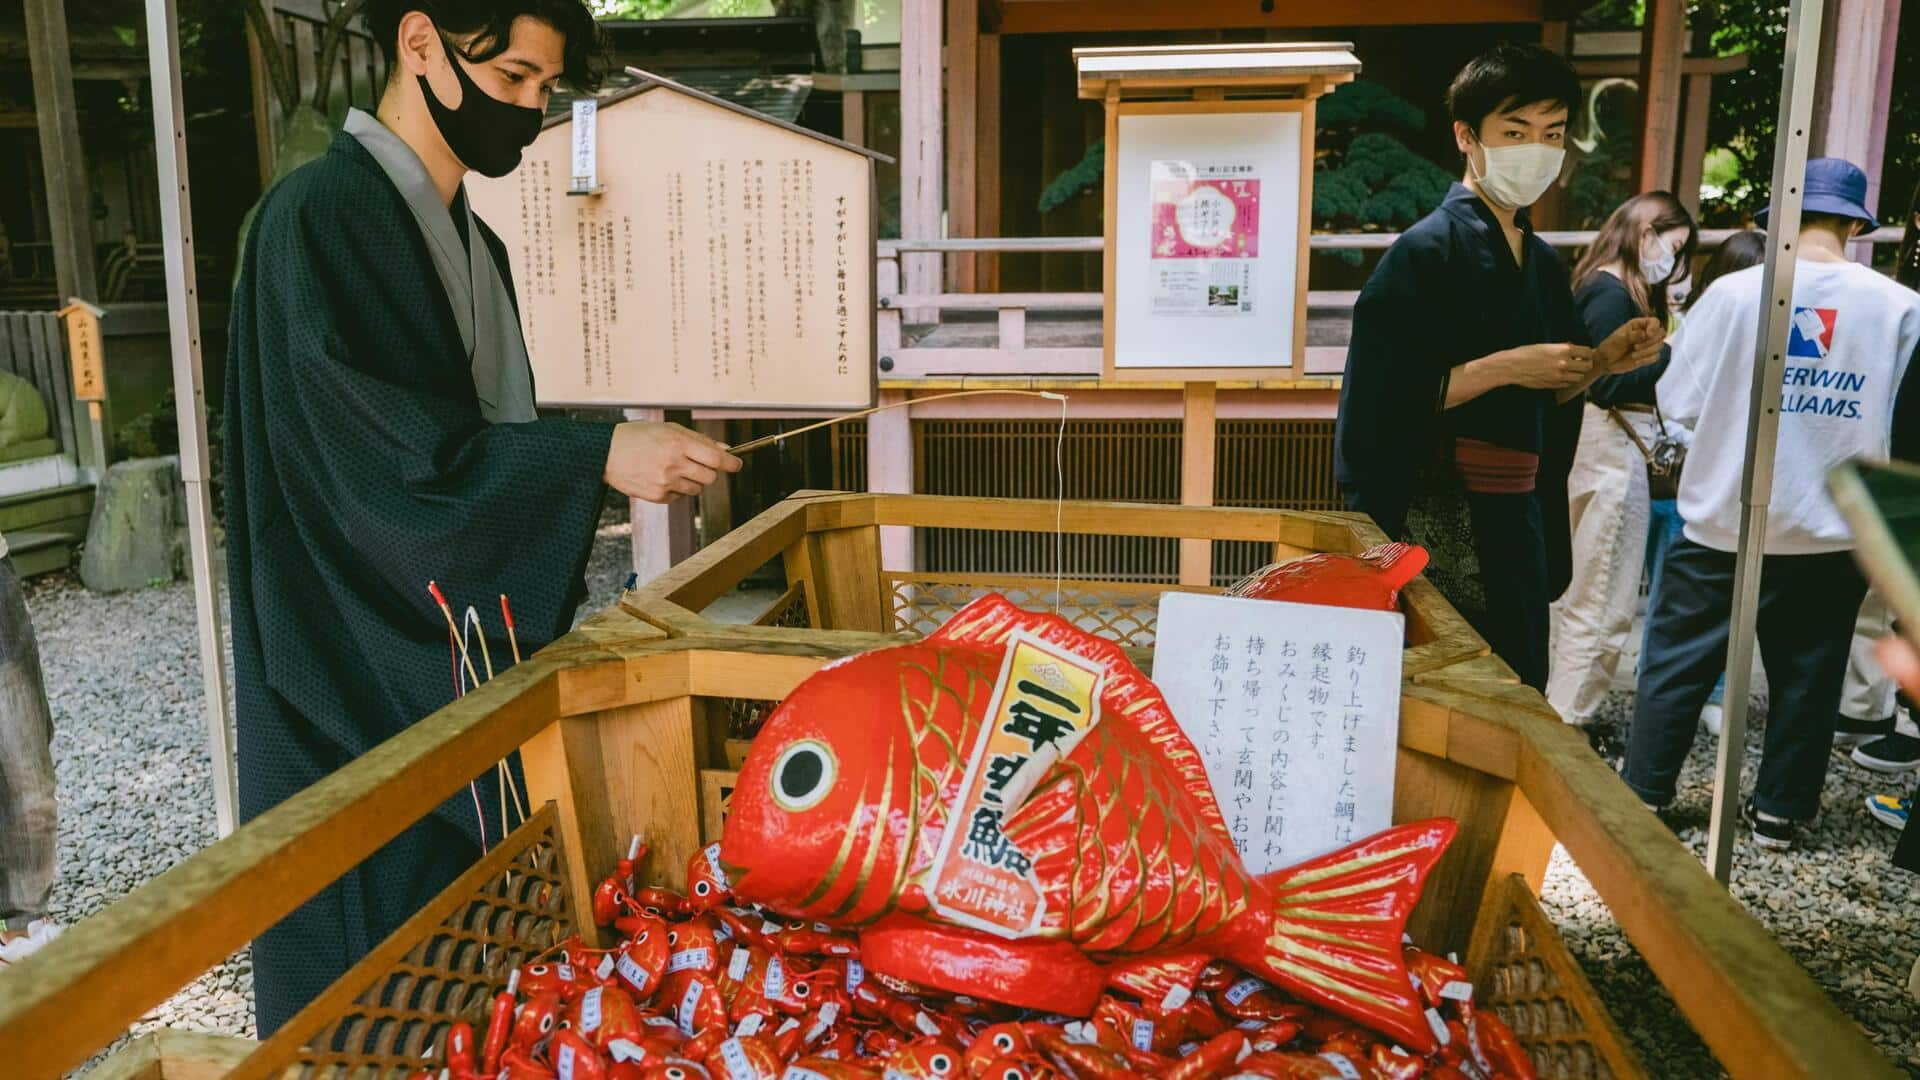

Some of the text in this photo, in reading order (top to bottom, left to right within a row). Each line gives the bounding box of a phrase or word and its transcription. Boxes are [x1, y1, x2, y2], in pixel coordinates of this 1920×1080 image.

[835, 195, 848, 375] すがすがしい毎日を過ごすために
[1204, 635, 1231, 770] お飾り下さい。
[1307, 643, 1333, 760] 縁起物です。
[1334, 645, 1366, 843] 釣り上げました鯛は
[942, 877, 1026, 921] 氷川神社
